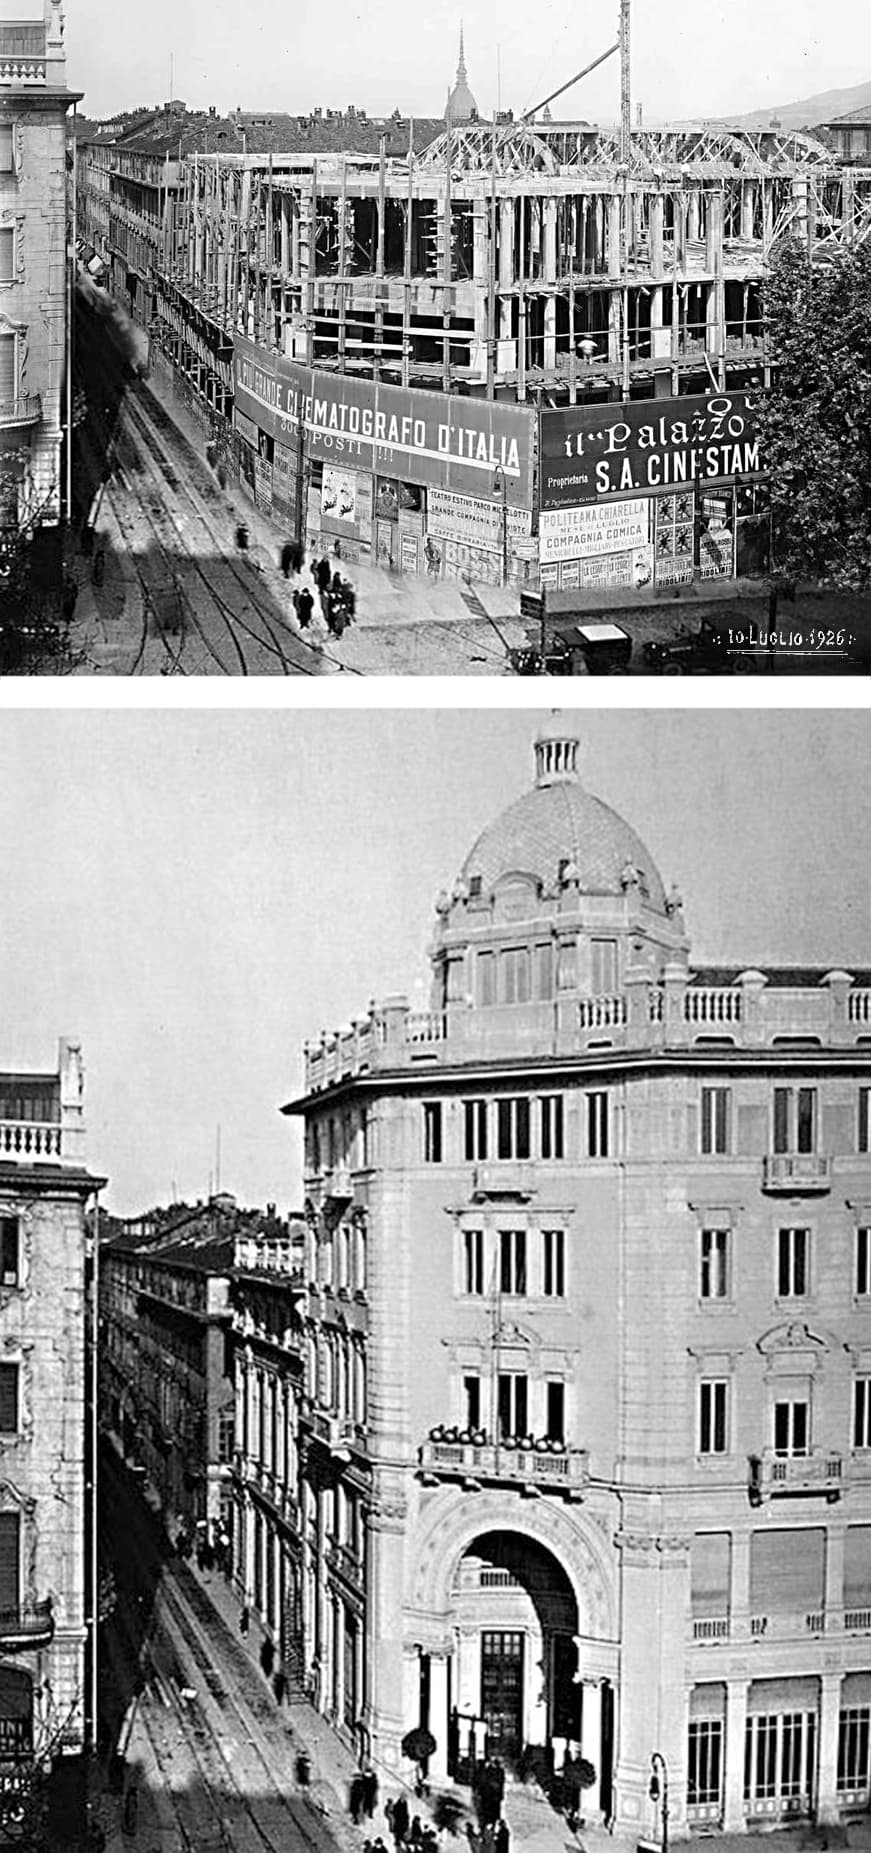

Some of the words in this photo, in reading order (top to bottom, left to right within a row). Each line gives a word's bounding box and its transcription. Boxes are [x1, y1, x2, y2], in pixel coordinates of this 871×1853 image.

[312, 431, 362, 455] POSTI
[438, 424, 520, 467] D'ITALIA
[564, 432, 585, 458] il
[430, 491, 451, 502] TEATRO
[492, 504, 529, 520] MICELOTTI
[544, 509, 597, 528] POLITEAMA
[599, 501, 645, 520] CHIARELLA
[546, 531, 602, 549] COMPAGNIA
[606, 524, 642, 540] COMICA
